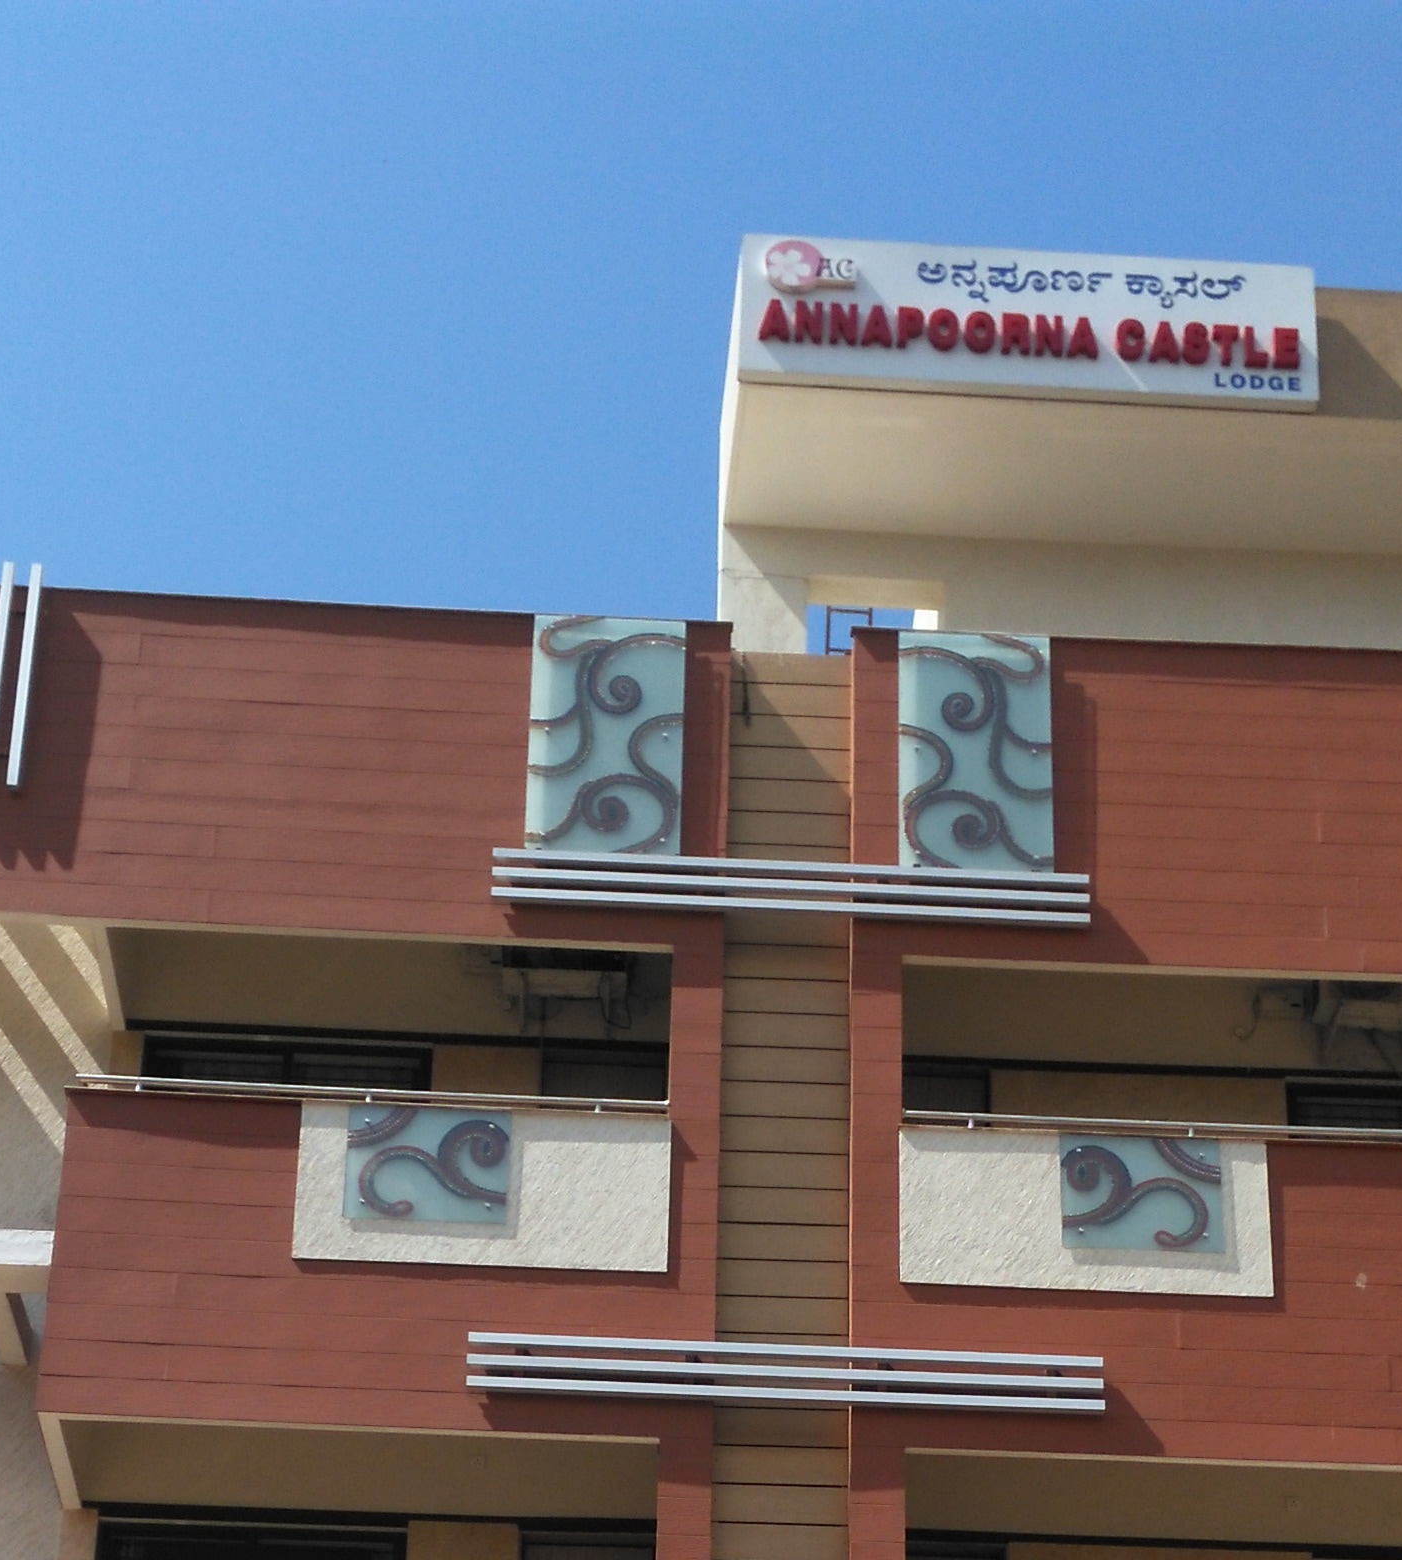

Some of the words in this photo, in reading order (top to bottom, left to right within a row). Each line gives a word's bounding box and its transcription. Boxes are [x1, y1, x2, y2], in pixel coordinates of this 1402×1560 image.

[917, 259, 1113, 303] ಅನ್ನಪೂರ್ಣ
[1125, 271, 1247, 309] ಕ್ಯಾಸಲ್
[758, 298, 1099, 359] ANNAPOORNA
[1114, 318, 1300, 368] CASTLE
[1214, 372, 1302, 392] LODGE
